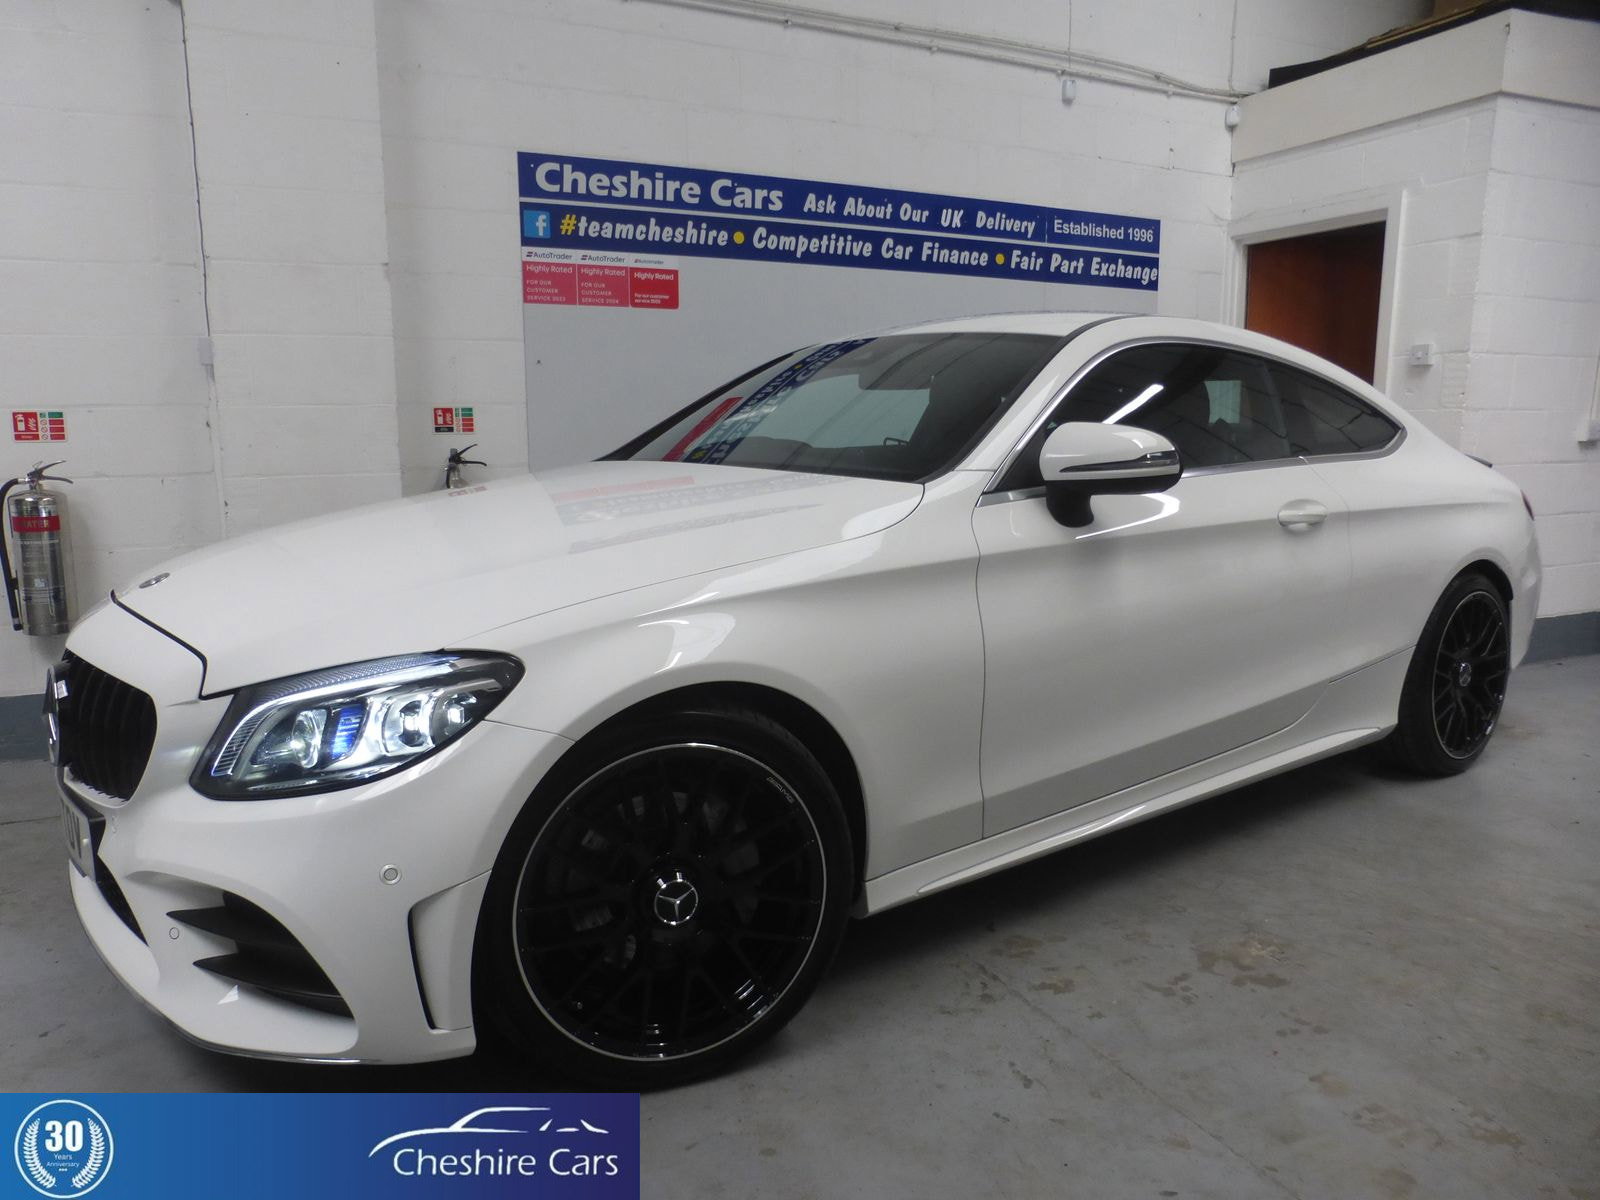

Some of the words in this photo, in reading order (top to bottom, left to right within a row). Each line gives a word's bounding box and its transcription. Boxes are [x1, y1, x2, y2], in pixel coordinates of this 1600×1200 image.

[535, 162, 701, 204] Cheshire
[710, 178, 784, 211] Cars
[803, 193, 836, 214] Ask
[843, 197, 893, 220] About
[899, 202, 930, 224] Our
[940, 208, 964, 228] UK
[975, 211, 1036, 238] Delivery
[560, 214, 728, 246] #teamcheshire
[1053, 219, 1125, 240] Established
[1127, 227, 1154, 244] 1996
[533, 251, 573, 262] AutoTrader
[588, 255, 626, 264] AutoTrader
[752, 227, 873, 259] Competitive
[880, 237, 914, 261] Car
[921, 242, 989, 267] Finance
[526, 264, 550, 274] Highly
[550, 266, 573, 274] Rated
[580, 267, 605, 277] Highly
[604, 268, 626, 277] Rated
[634, 271, 655, 281] Highly
[655, 273, 675, 281] Rated
[1010, 250, 1043, 272] Fair
[1050, 254, 1085, 276] Part
[1091, 257, 1159, 286] Exchange
